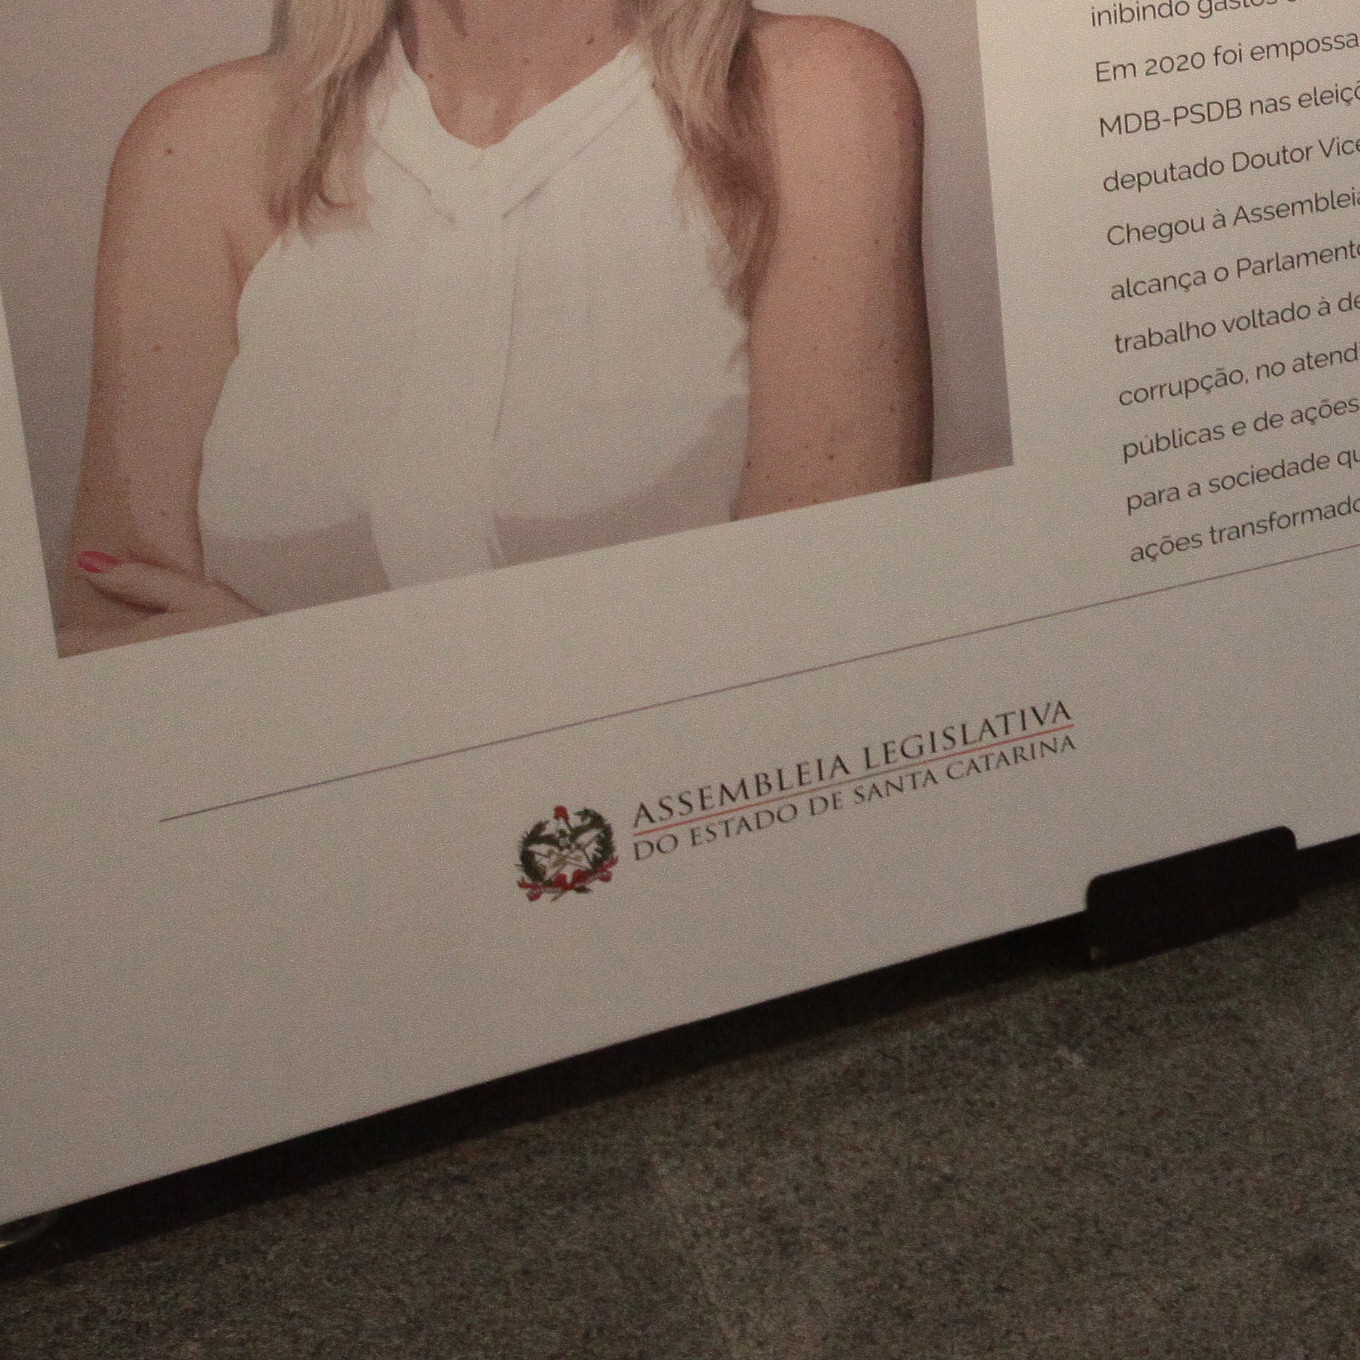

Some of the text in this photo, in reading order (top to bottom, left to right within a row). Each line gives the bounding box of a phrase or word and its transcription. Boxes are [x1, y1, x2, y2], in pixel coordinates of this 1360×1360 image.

[1097, 96, 1243, 138] MDB-PSDB
[1248, 94, 1292, 116] nas
[1105, 215, 1206, 247] Chegou
[1210, 207, 1227, 231] à
[1113, 319, 1217, 355] trabalho
[1220, 300, 1312, 334] voltado
[1315, 295, 1332, 318] à
[1121, 422, 1226, 465] públicas
[1229, 419, 1247, 438] e
[1251, 409, 1285, 433] de
[1288, 395, 1360, 426] ações
[633, 699, 1073, 829] ASSEMBLEIA LEGISLATIVA
[633, 734, 1078, 862] DO ESTADO DE SANTA CATARINA
